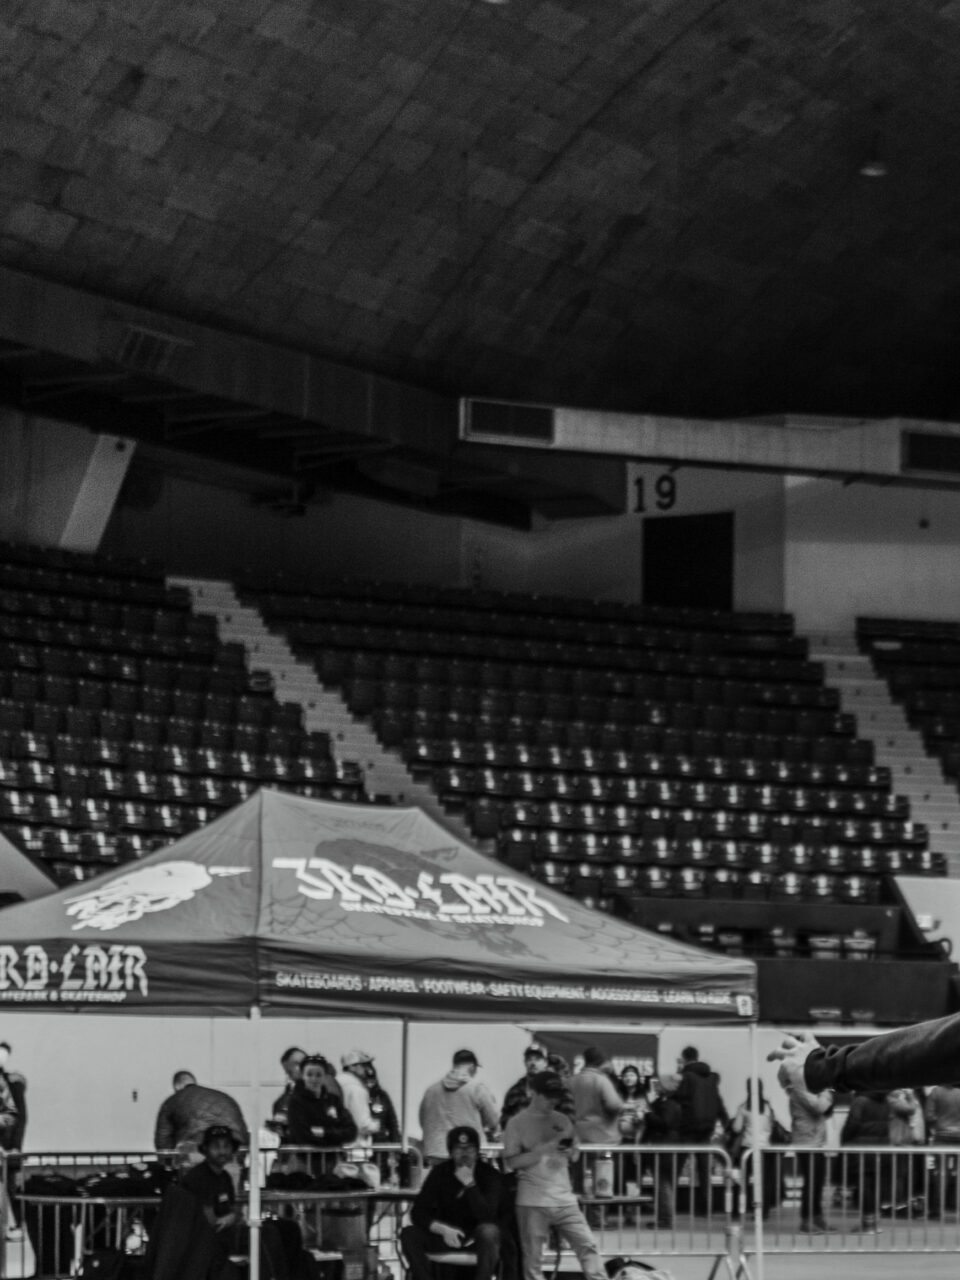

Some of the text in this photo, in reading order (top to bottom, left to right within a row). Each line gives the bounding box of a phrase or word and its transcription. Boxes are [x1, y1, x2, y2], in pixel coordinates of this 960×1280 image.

[634, 474, 676, 513] 19
[275, 971, 362, 991] SKATEBOARDS
[368, 975, 419, 993] APPAREL
[422, 978, 486, 995] FOOTWEAR
